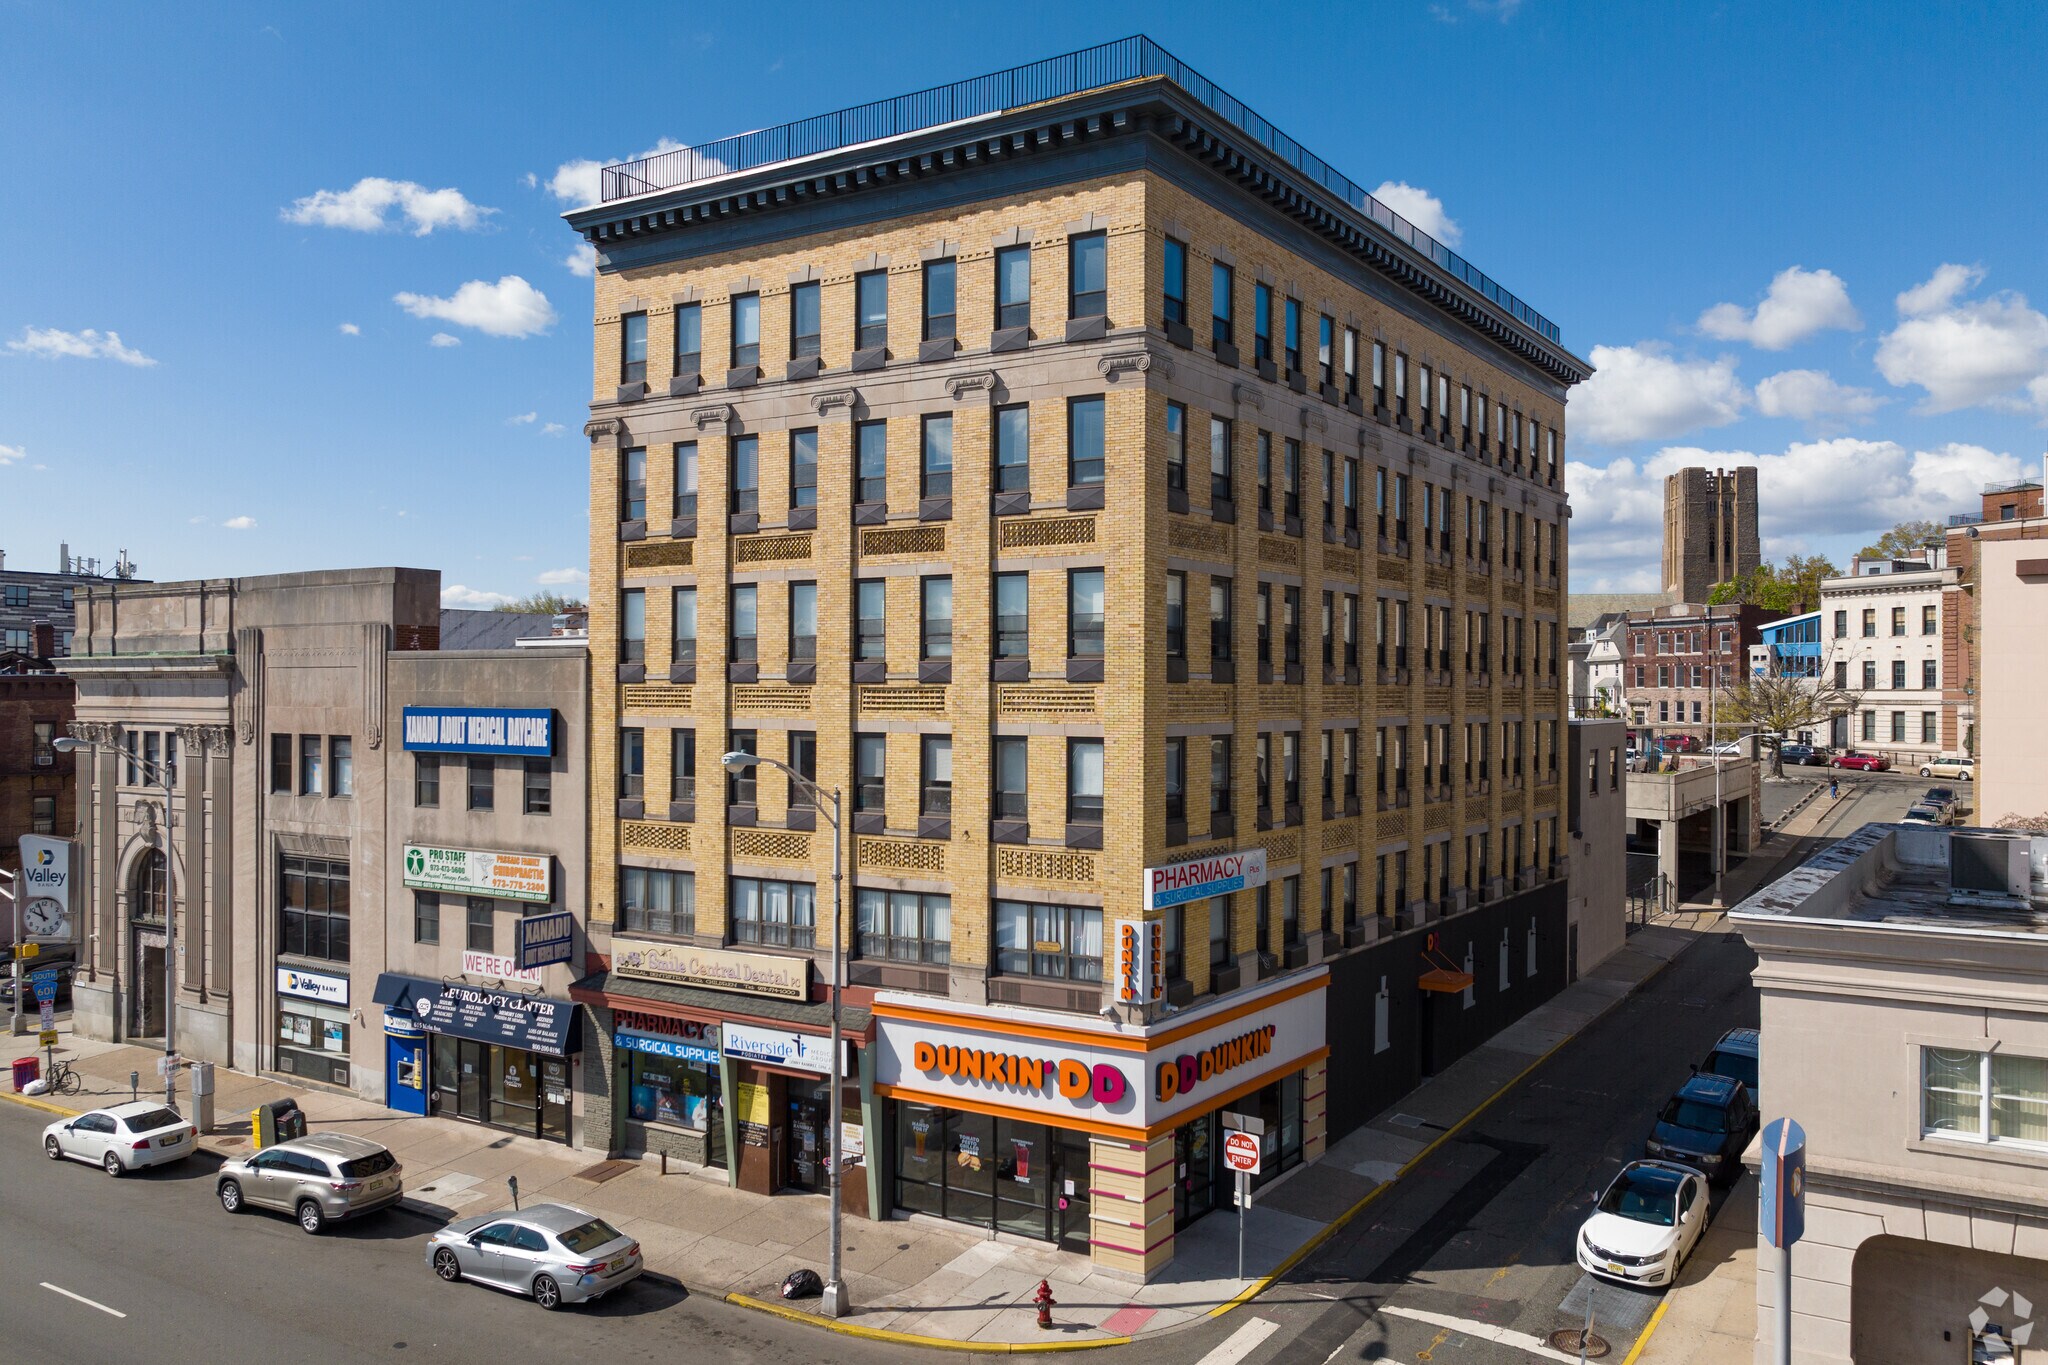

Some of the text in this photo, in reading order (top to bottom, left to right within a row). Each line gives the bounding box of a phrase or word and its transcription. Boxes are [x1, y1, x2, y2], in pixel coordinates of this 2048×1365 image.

[406, 715, 548, 747] XANADU ADULT MEDICAL DAYCARE
[429, 849, 467, 862] PRO STAFF
[496, 855, 541, 867] PASSAIC FAMILY
[26, 868, 66, 887] Valley
[493, 865, 545, 881] CHIROPRACTIC
[1153, 855, 1260, 893] PHARMACY Plus
[1155, 877, 1244, 905] & SURGICAL SUPPLIES
[526, 915, 571, 945] XANADU
[465, 953, 500, 975] WE'RE
[648, 952, 687, 974] Smile
[689, 957, 742, 980] Central
[743, 963, 789, 987] Dental
[34, 972, 56, 980] SOUTH
[300, 977, 321, 995] Valley
[618, 968, 647, 976] GENERAL
[705, 979, 737, 988] CHILDREN
[38, 987, 54, 996] 601
[440, 986, 555, 1016] NEUROLOGY CENTER
[615, 1009, 706, 1040] PHARMACY
[615, 1035, 622, 1047] &
[626, 1037, 674, 1055] SURGICAL
[730, 1033, 793, 1058] Riverside
[741, 1050, 768, 1060] PODIATRY
[1199, 1024, 1276, 1082] DUNKIN'
[914, 1041, 1053, 1090] DUNKIN'
[959, 1134, 980, 1143] TOMATO
[1230, 1138, 1253, 1149] DO NOT
[1231, 1154, 1252, 1165] ENTER
